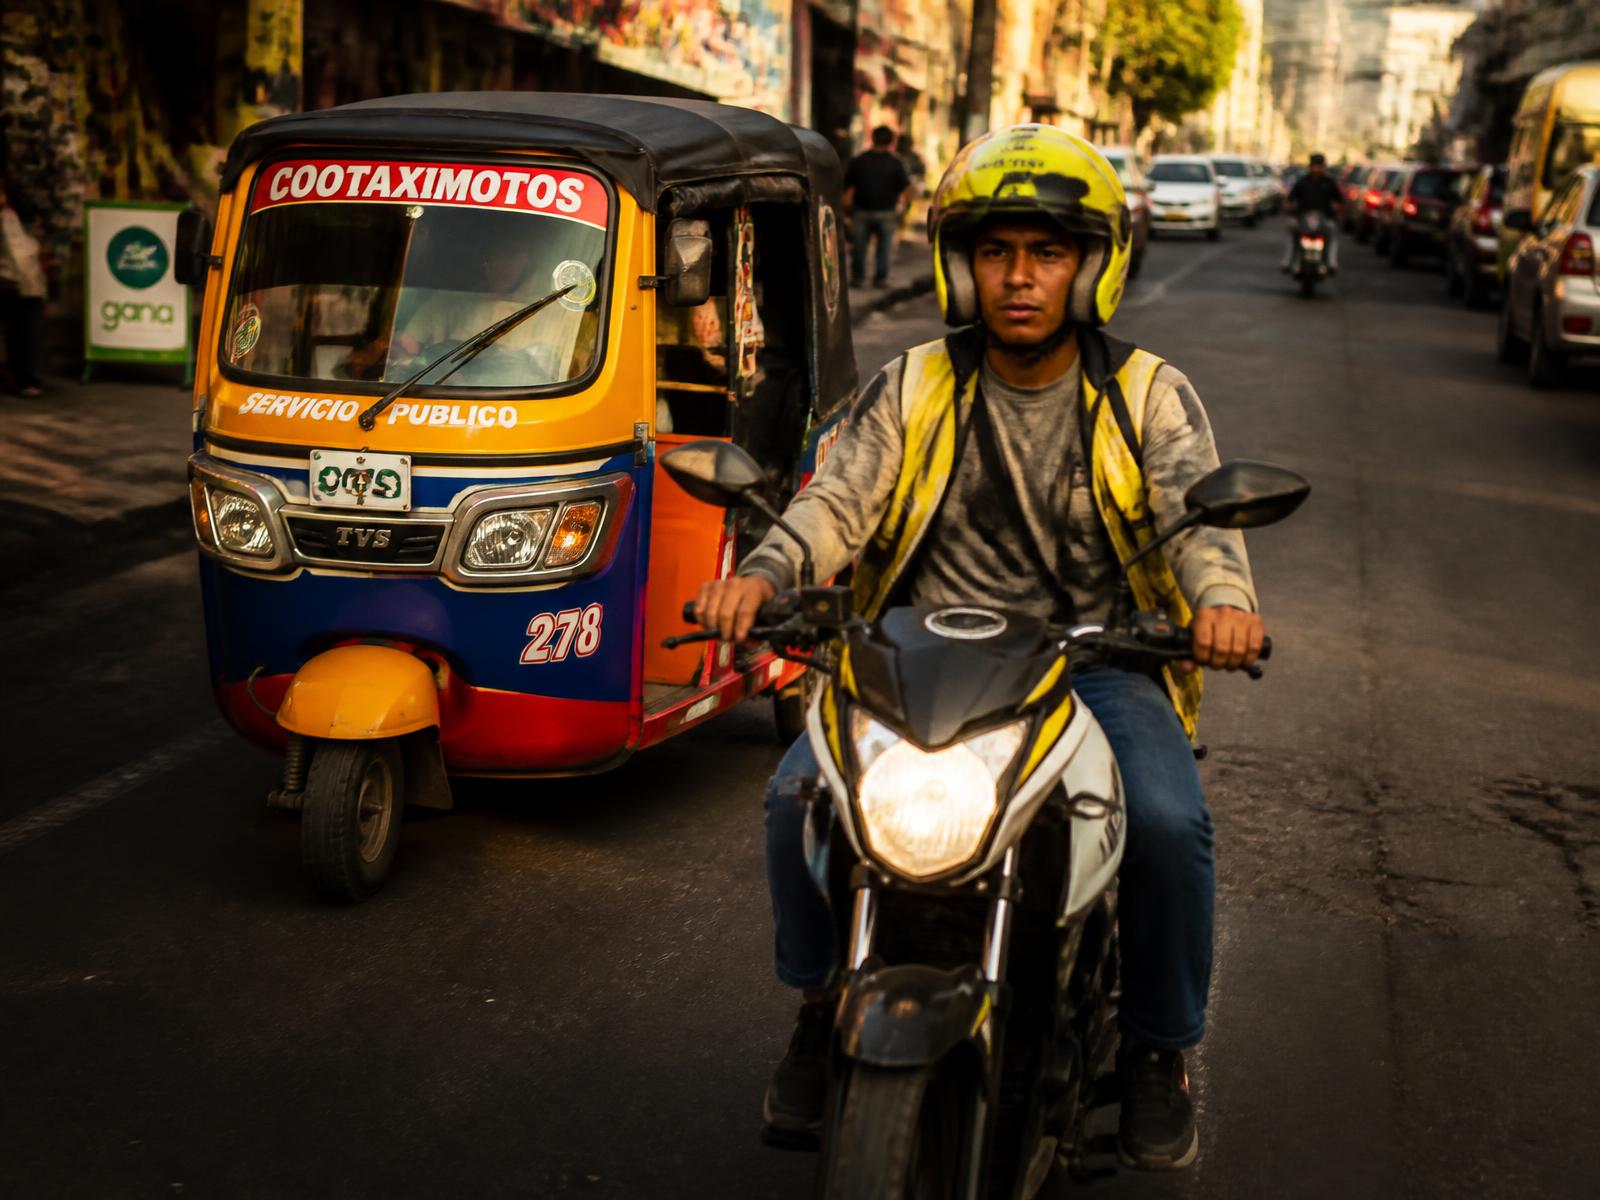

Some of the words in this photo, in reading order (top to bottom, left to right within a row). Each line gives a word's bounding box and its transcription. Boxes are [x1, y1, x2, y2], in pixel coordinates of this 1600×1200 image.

[270, 164, 585, 213] COOTAXIMOTOS
[102, 301, 174, 332] gana
[238, 392, 360, 422] SERVICIO
[387, 403, 518, 429] PUBLICO
[336, 526, 392, 549] TVS
[519, 602, 604, 664] 278
